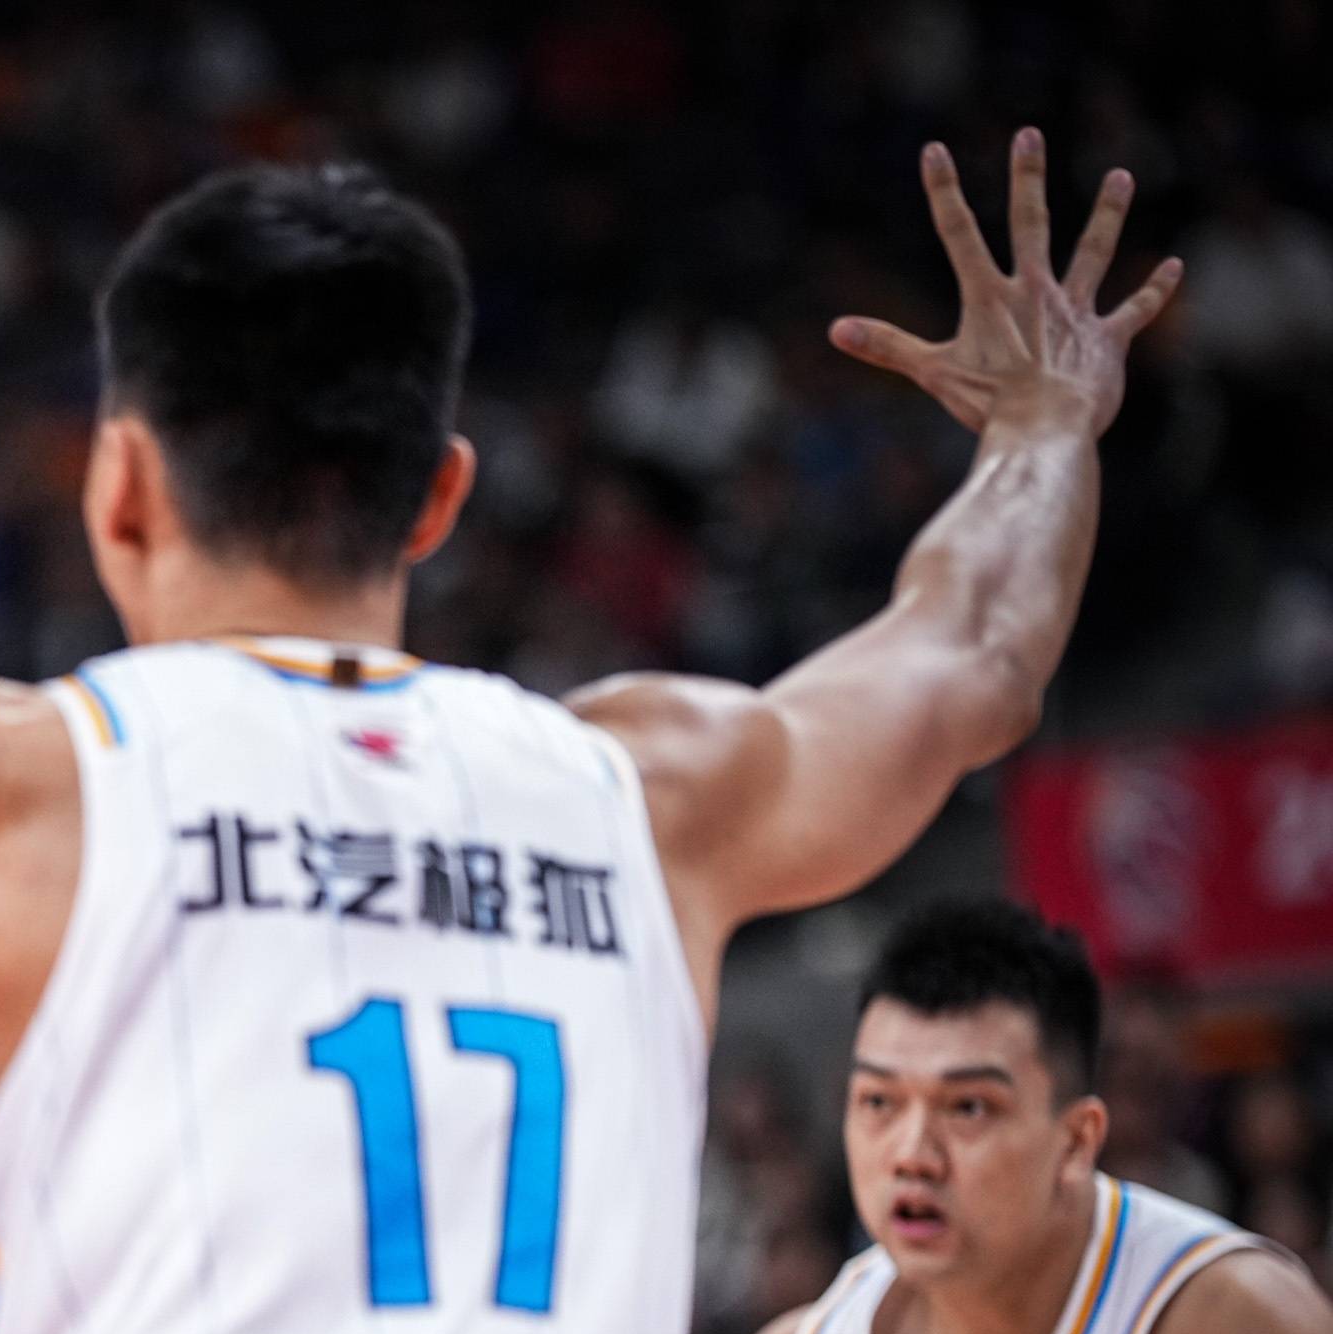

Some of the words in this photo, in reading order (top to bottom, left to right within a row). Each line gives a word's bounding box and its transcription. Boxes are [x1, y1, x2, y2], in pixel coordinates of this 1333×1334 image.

[177, 811, 625, 958] 北汽极狐
[307, 994, 567, 1314] 17
